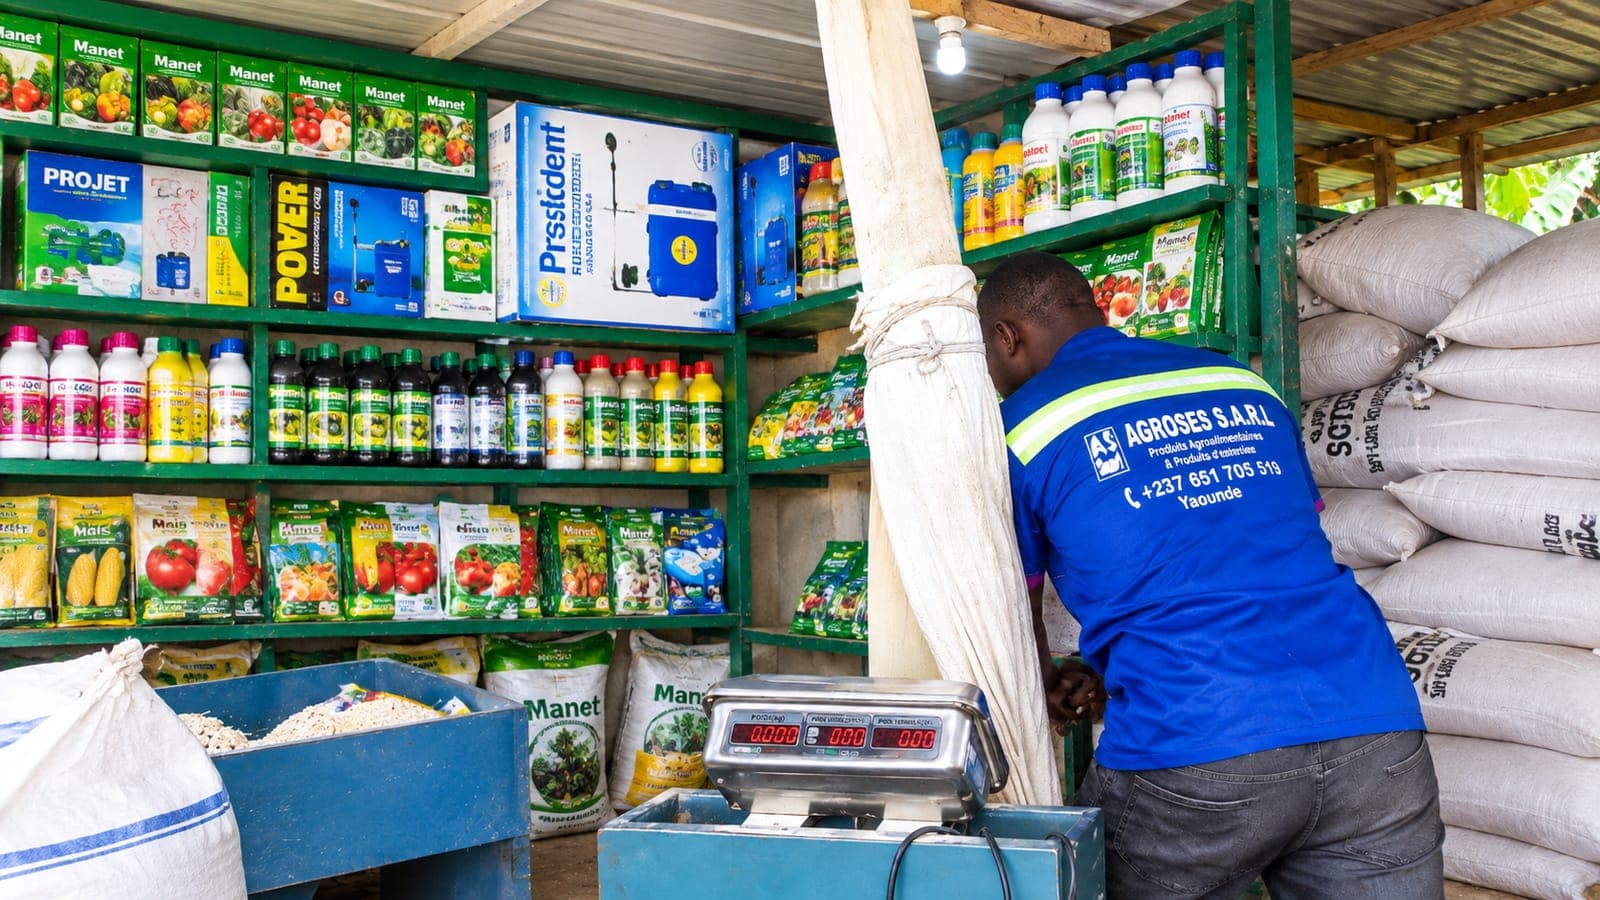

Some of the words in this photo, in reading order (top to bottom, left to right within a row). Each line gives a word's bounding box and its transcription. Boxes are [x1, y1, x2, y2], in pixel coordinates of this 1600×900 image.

[74, 39, 124, 60] Manet
[154, 54, 202, 73] Manet
[229, 65, 274, 83] Manet
[299, 75, 341, 93] Manet
[365, 86, 405, 102] Manet
[427, 95, 465, 111] Manet
[43, 167, 130, 193] PROJET
[1124, 409, 1213, 448] AGROSES
[1174, 452, 1212, 467] Produits
[1142, 475, 1183, 499] +237
[1188, 468, 1220, 487] 651
[1221, 462, 1255, 480] 705
[1256, 461, 1282, 475] 519
[1177, 485, 1243, 510] Yaounde
[654, 684, 706, 704] Man
[523, 695, 601, 721] Manet
[750, 726, 799, 743] 0.000
